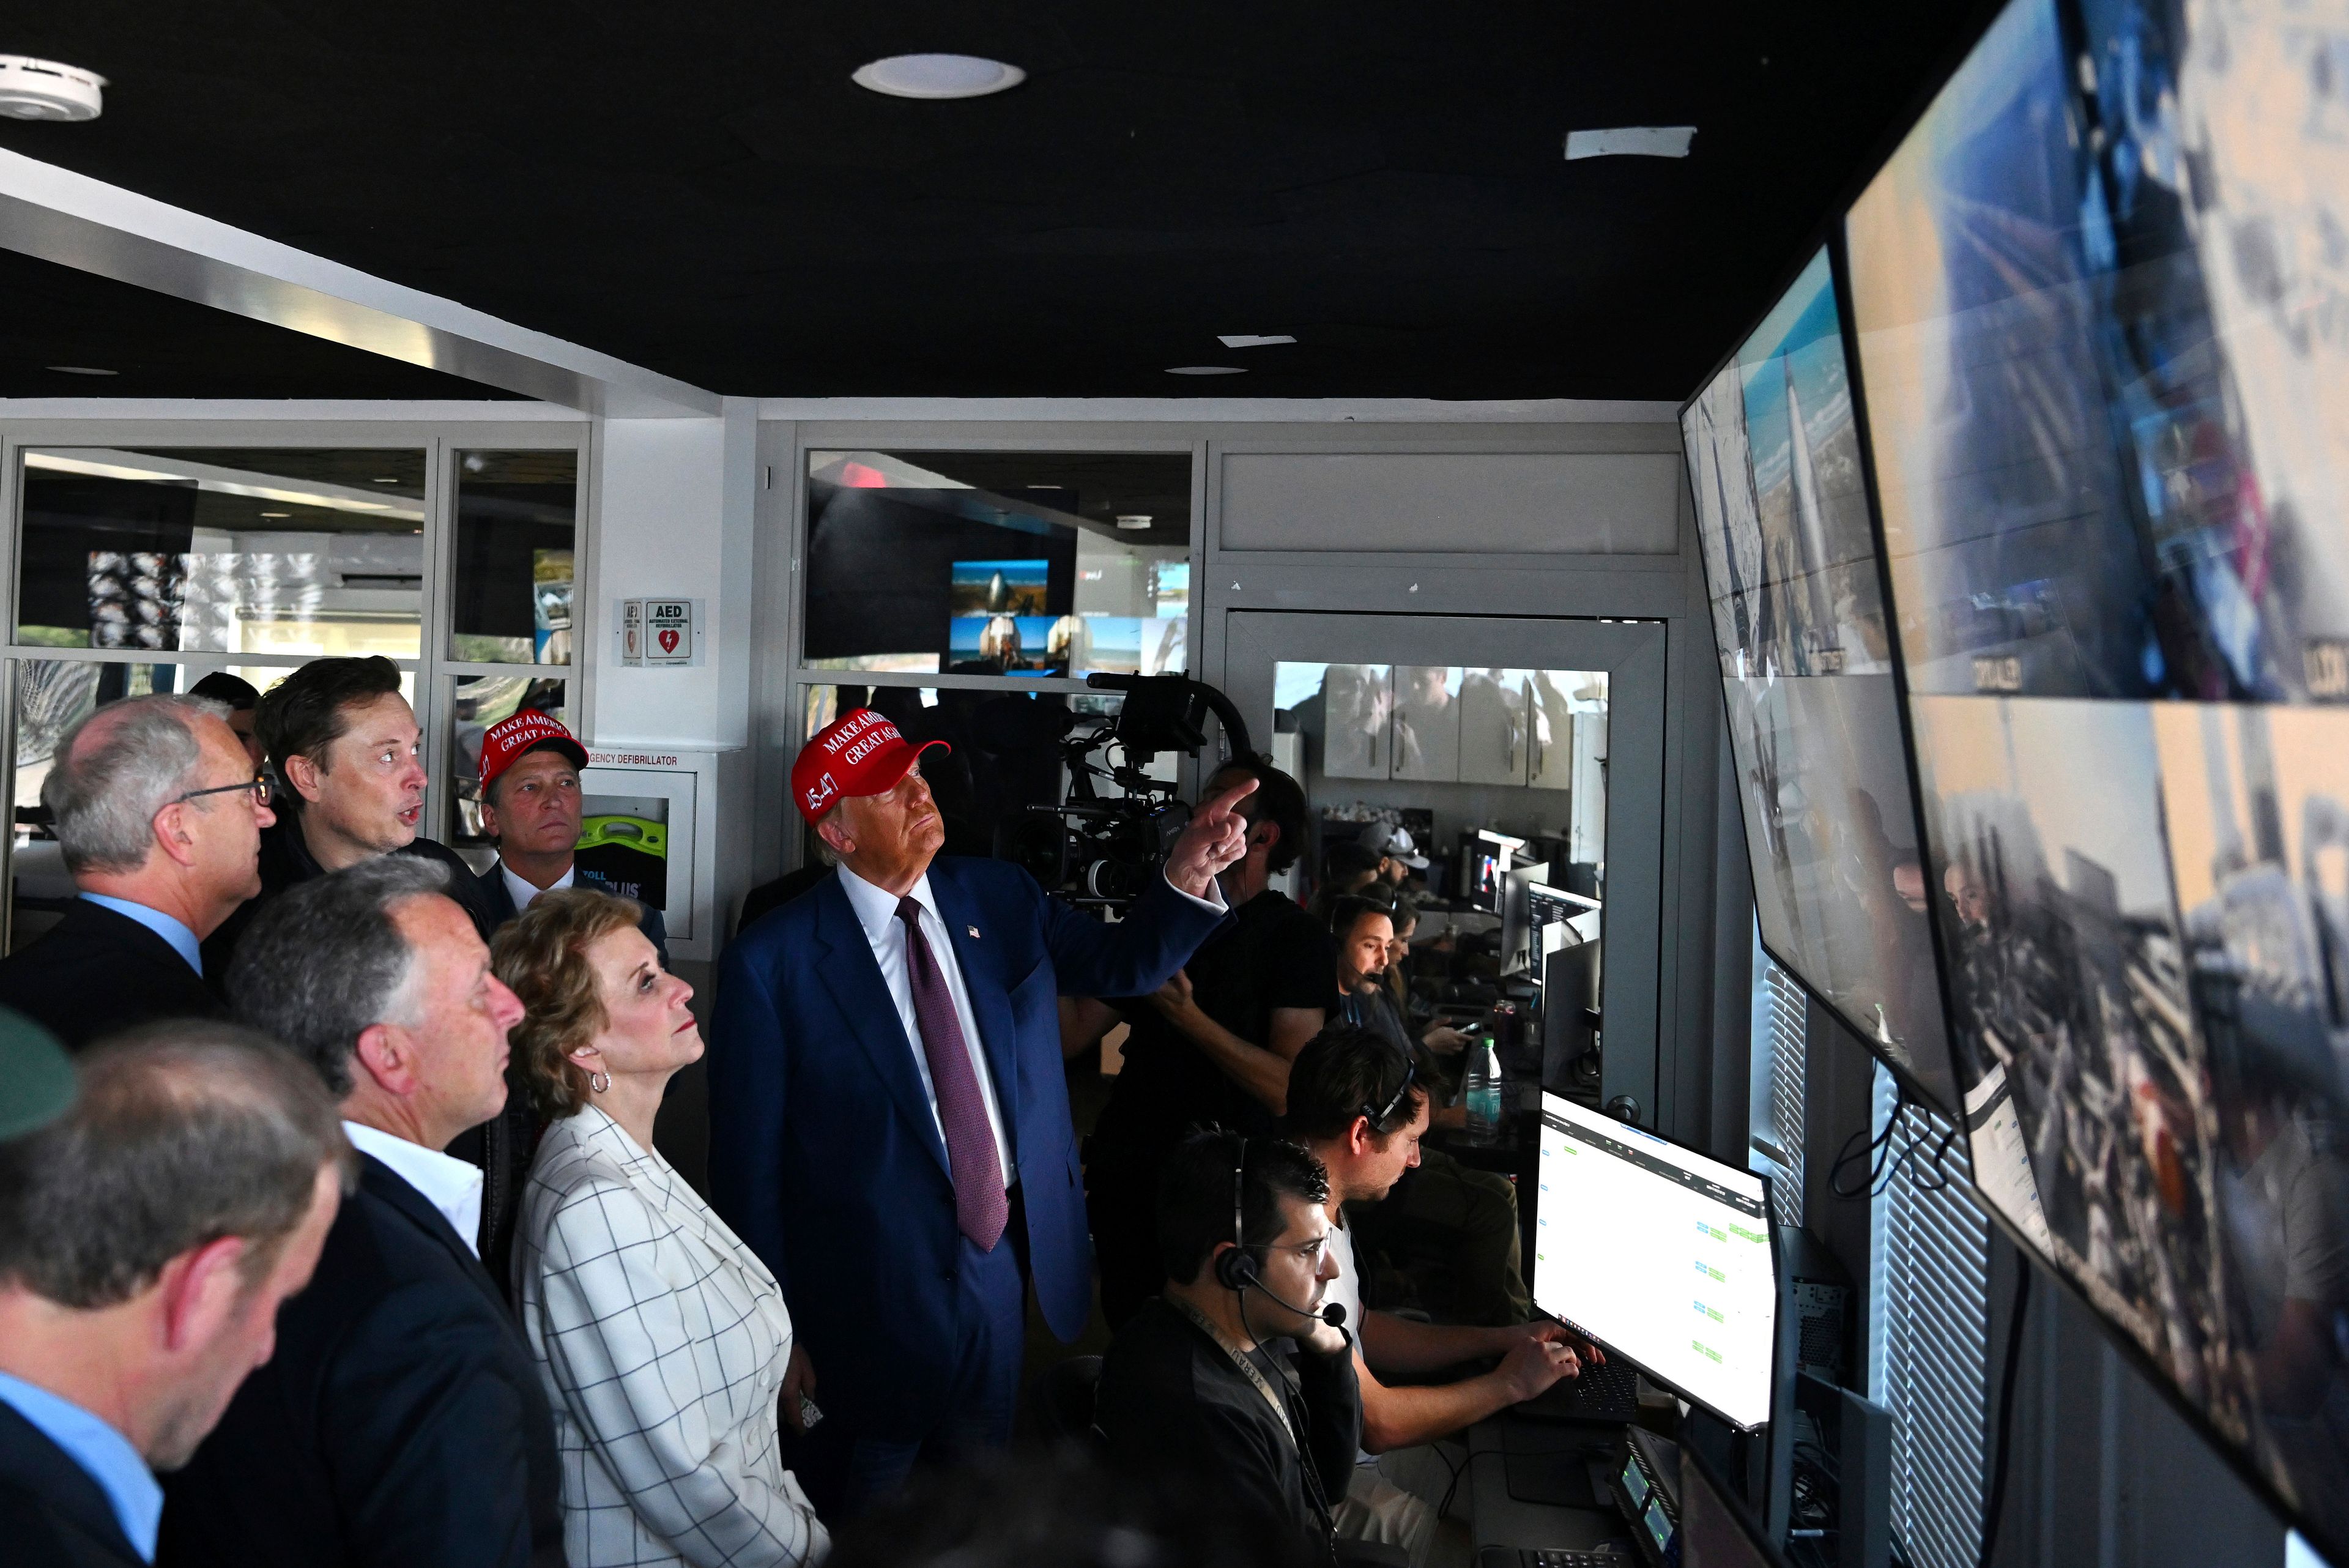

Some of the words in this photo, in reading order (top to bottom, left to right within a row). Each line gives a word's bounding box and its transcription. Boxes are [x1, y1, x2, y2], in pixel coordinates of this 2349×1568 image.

[656, 605, 682, 618] AED
[490, 718, 524, 742] MAKE
[501, 729, 538, 752] GREAT
[823, 721, 862, 755] MAKE
[590, 753, 616, 764] GENCY
[618, 754, 677, 765] DEFIBRILLATOR
[845, 731, 885, 765] GREAT
[806, 772, 839, 810] 45-47
